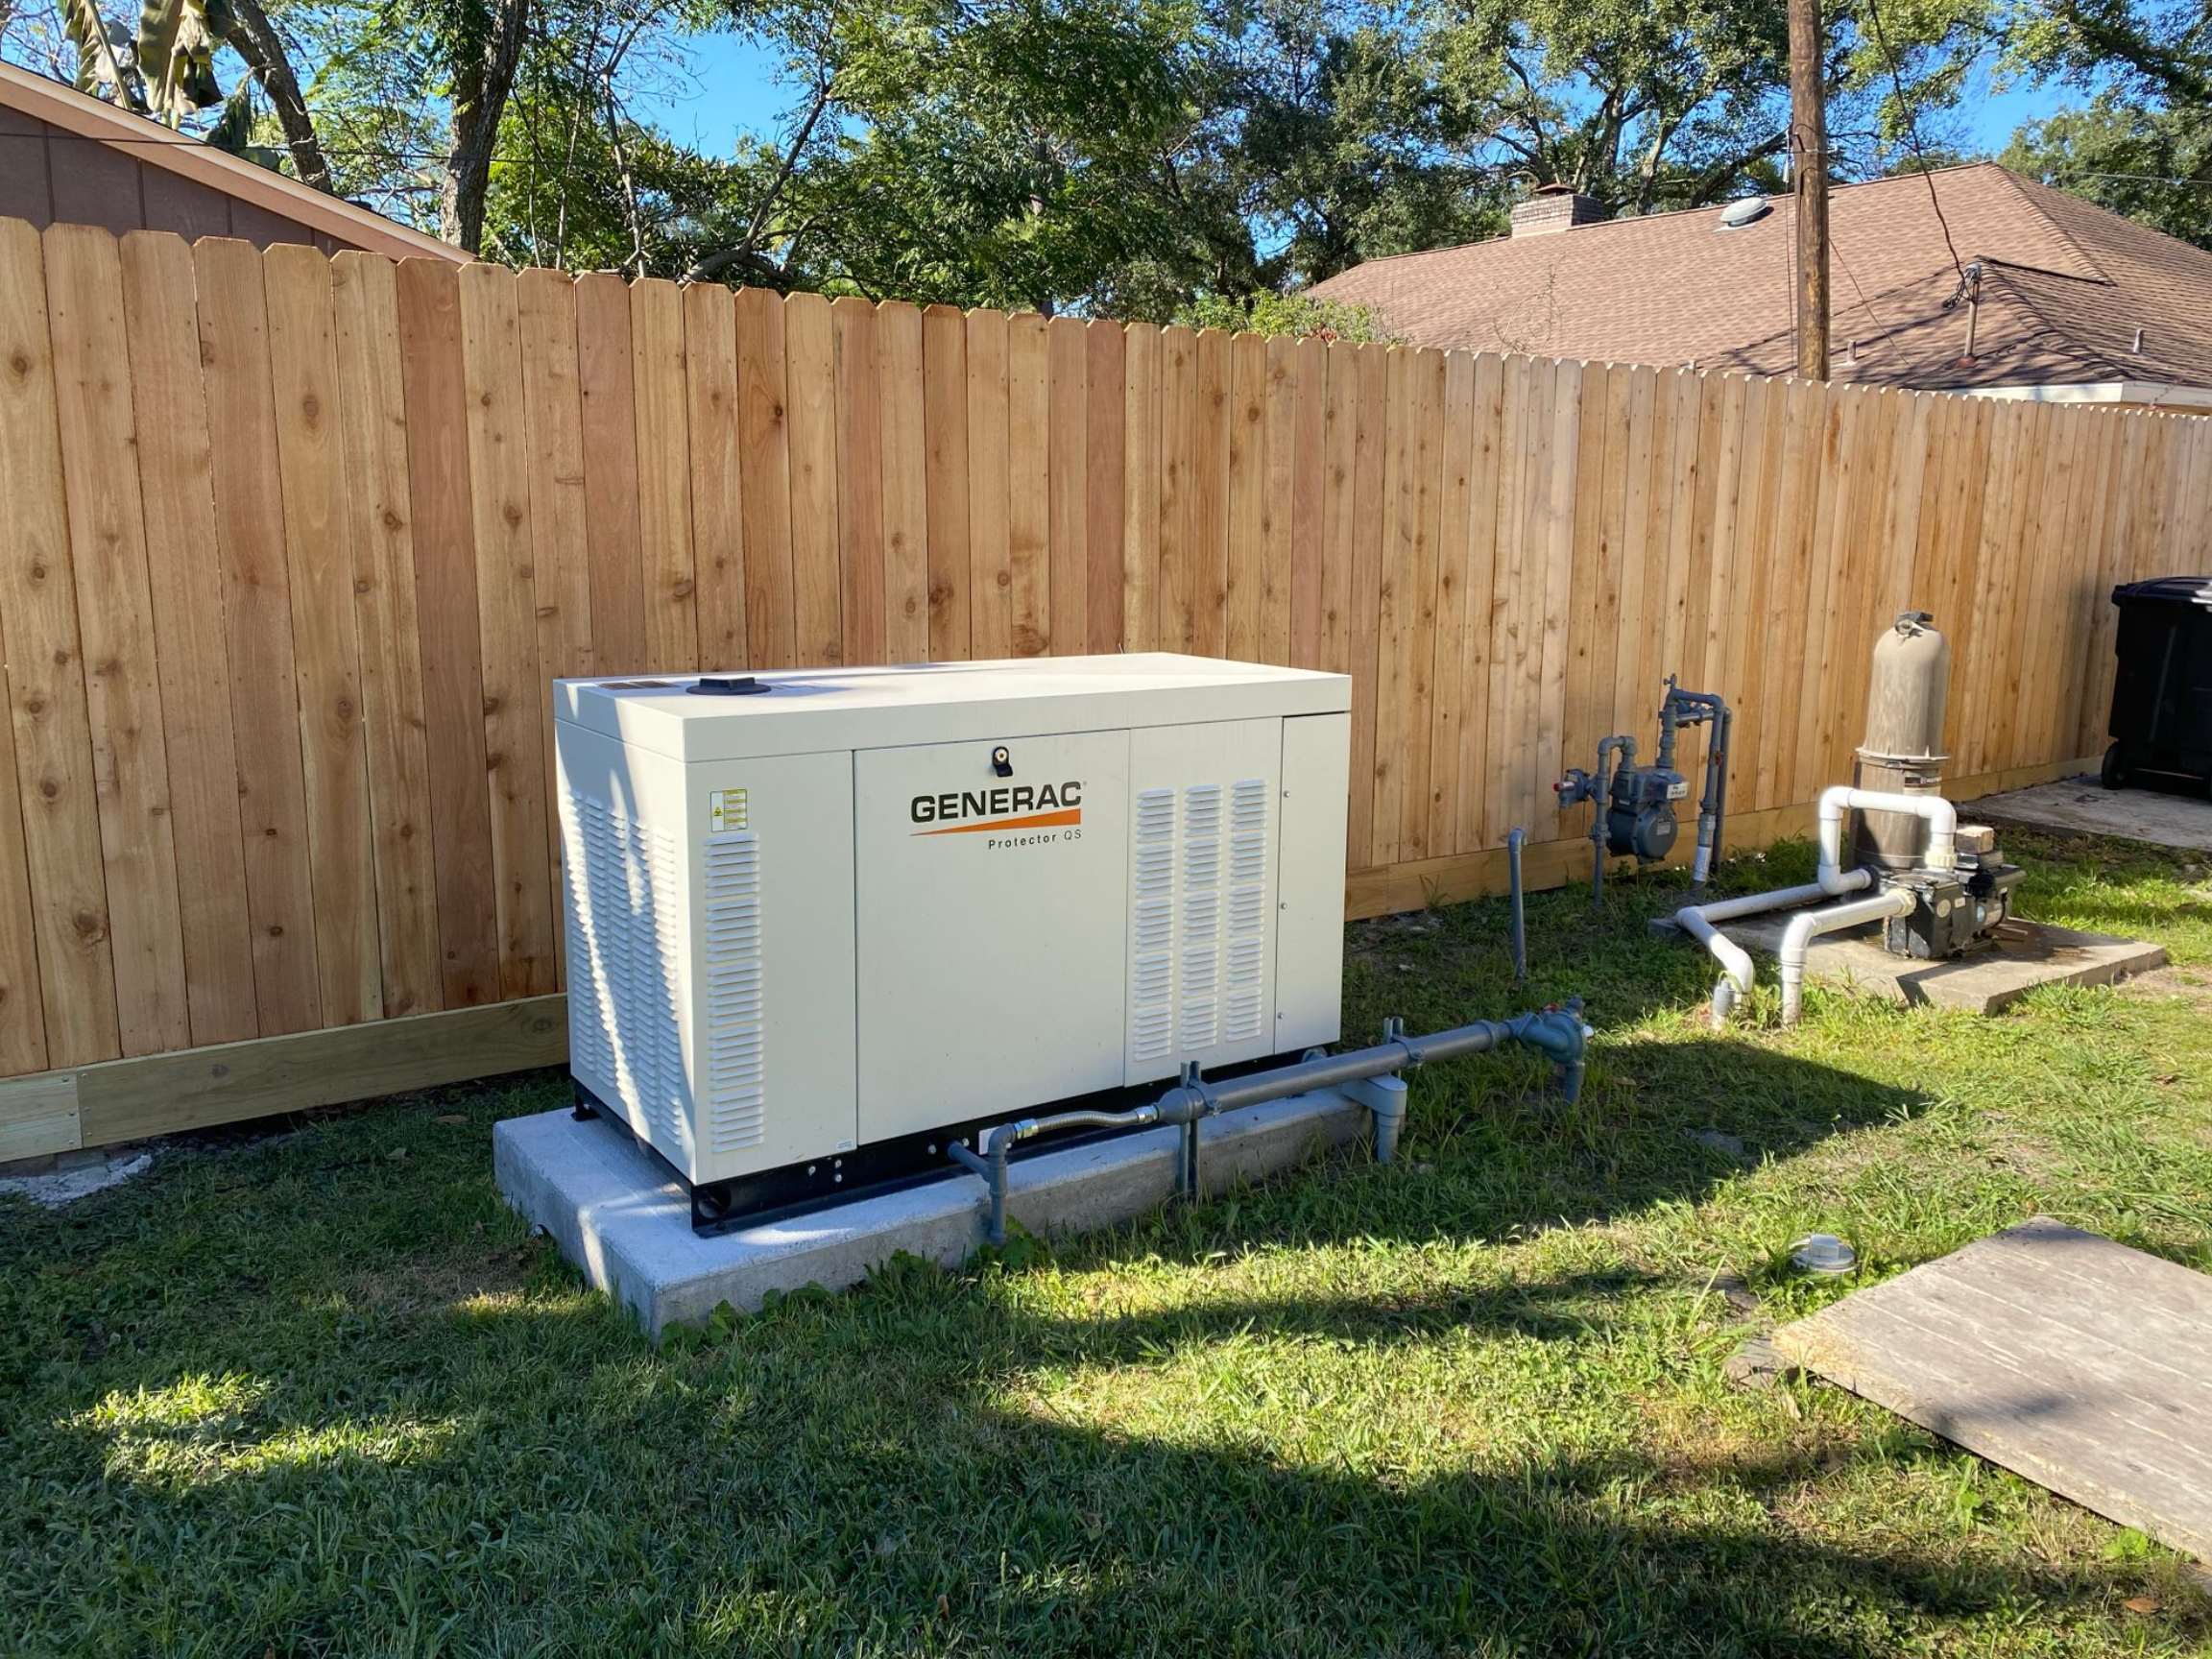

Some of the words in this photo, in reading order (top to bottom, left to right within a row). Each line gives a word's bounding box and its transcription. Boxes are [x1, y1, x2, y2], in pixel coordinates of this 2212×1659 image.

[911, 781, 1081, 823] GENERAC
[988, 834, 1057, 850] Protector
[1064, 829, 1082, 841] QS
